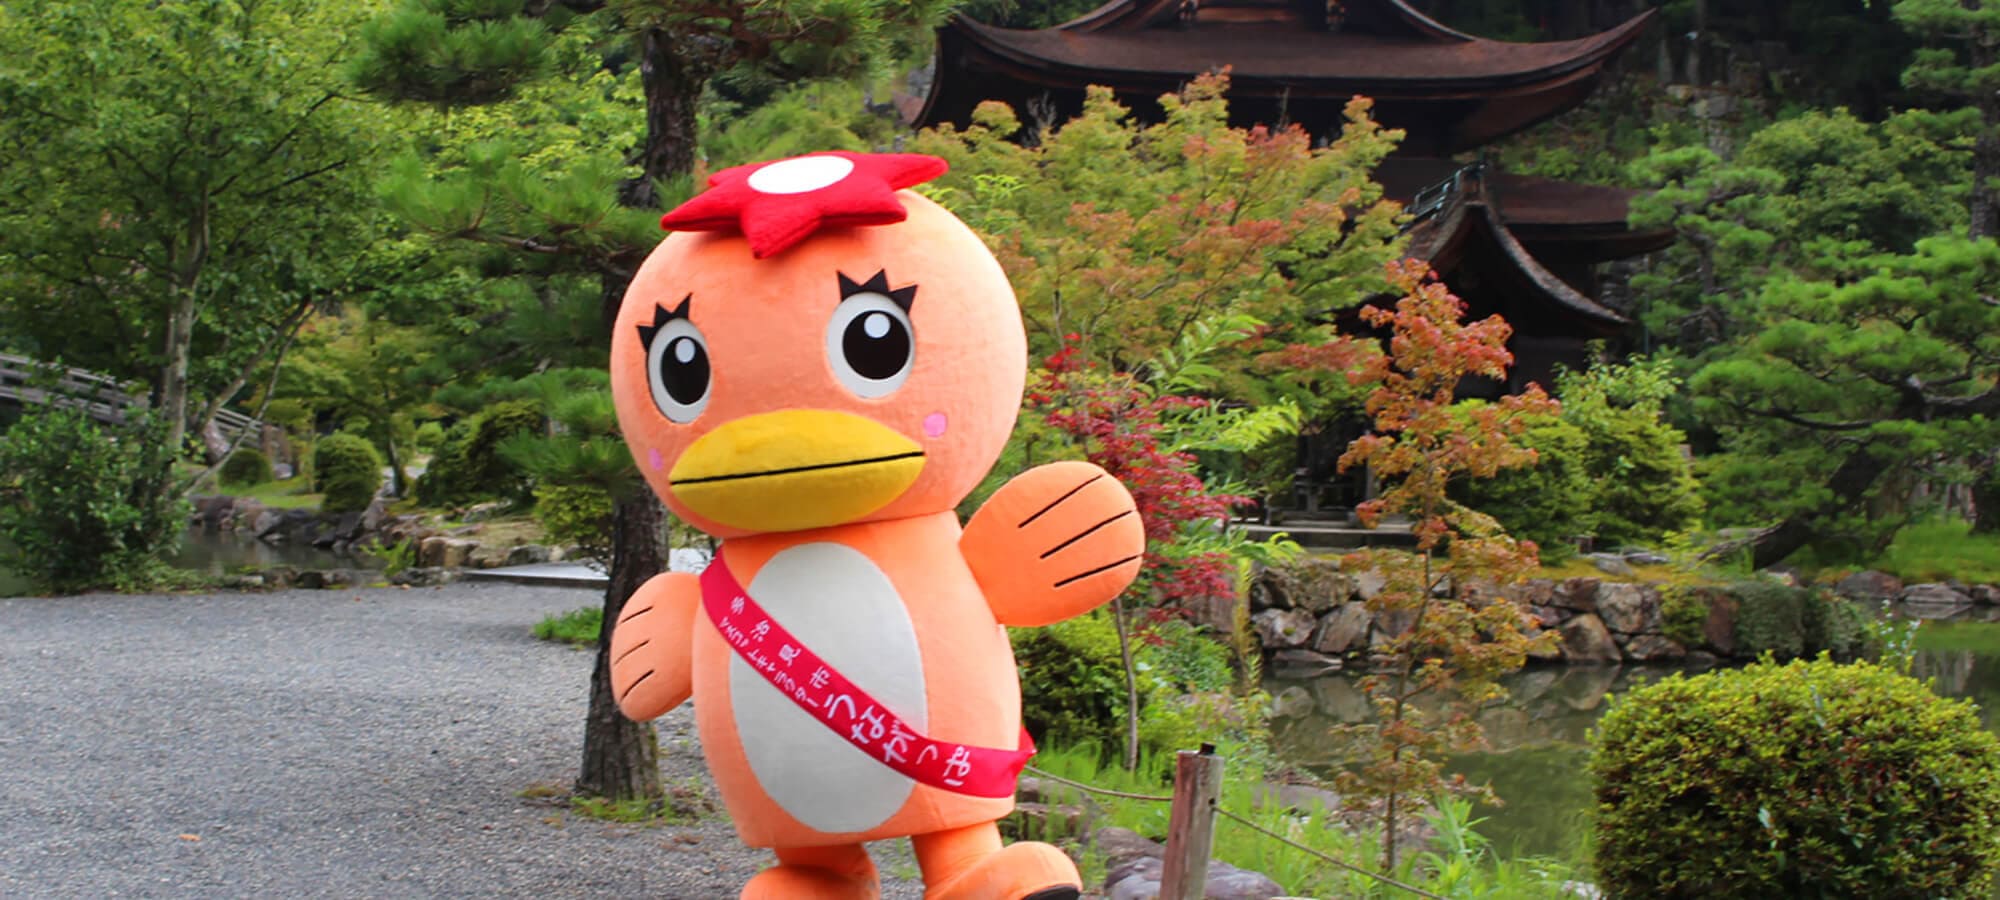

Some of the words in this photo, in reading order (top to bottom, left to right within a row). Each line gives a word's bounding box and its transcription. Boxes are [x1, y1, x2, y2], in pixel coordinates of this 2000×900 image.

[720, 616, 819, 708] マスコットキャラクター
[731, 596, 831, 689] 多治見市
[823, 693, 971, 786] うながっぱ
